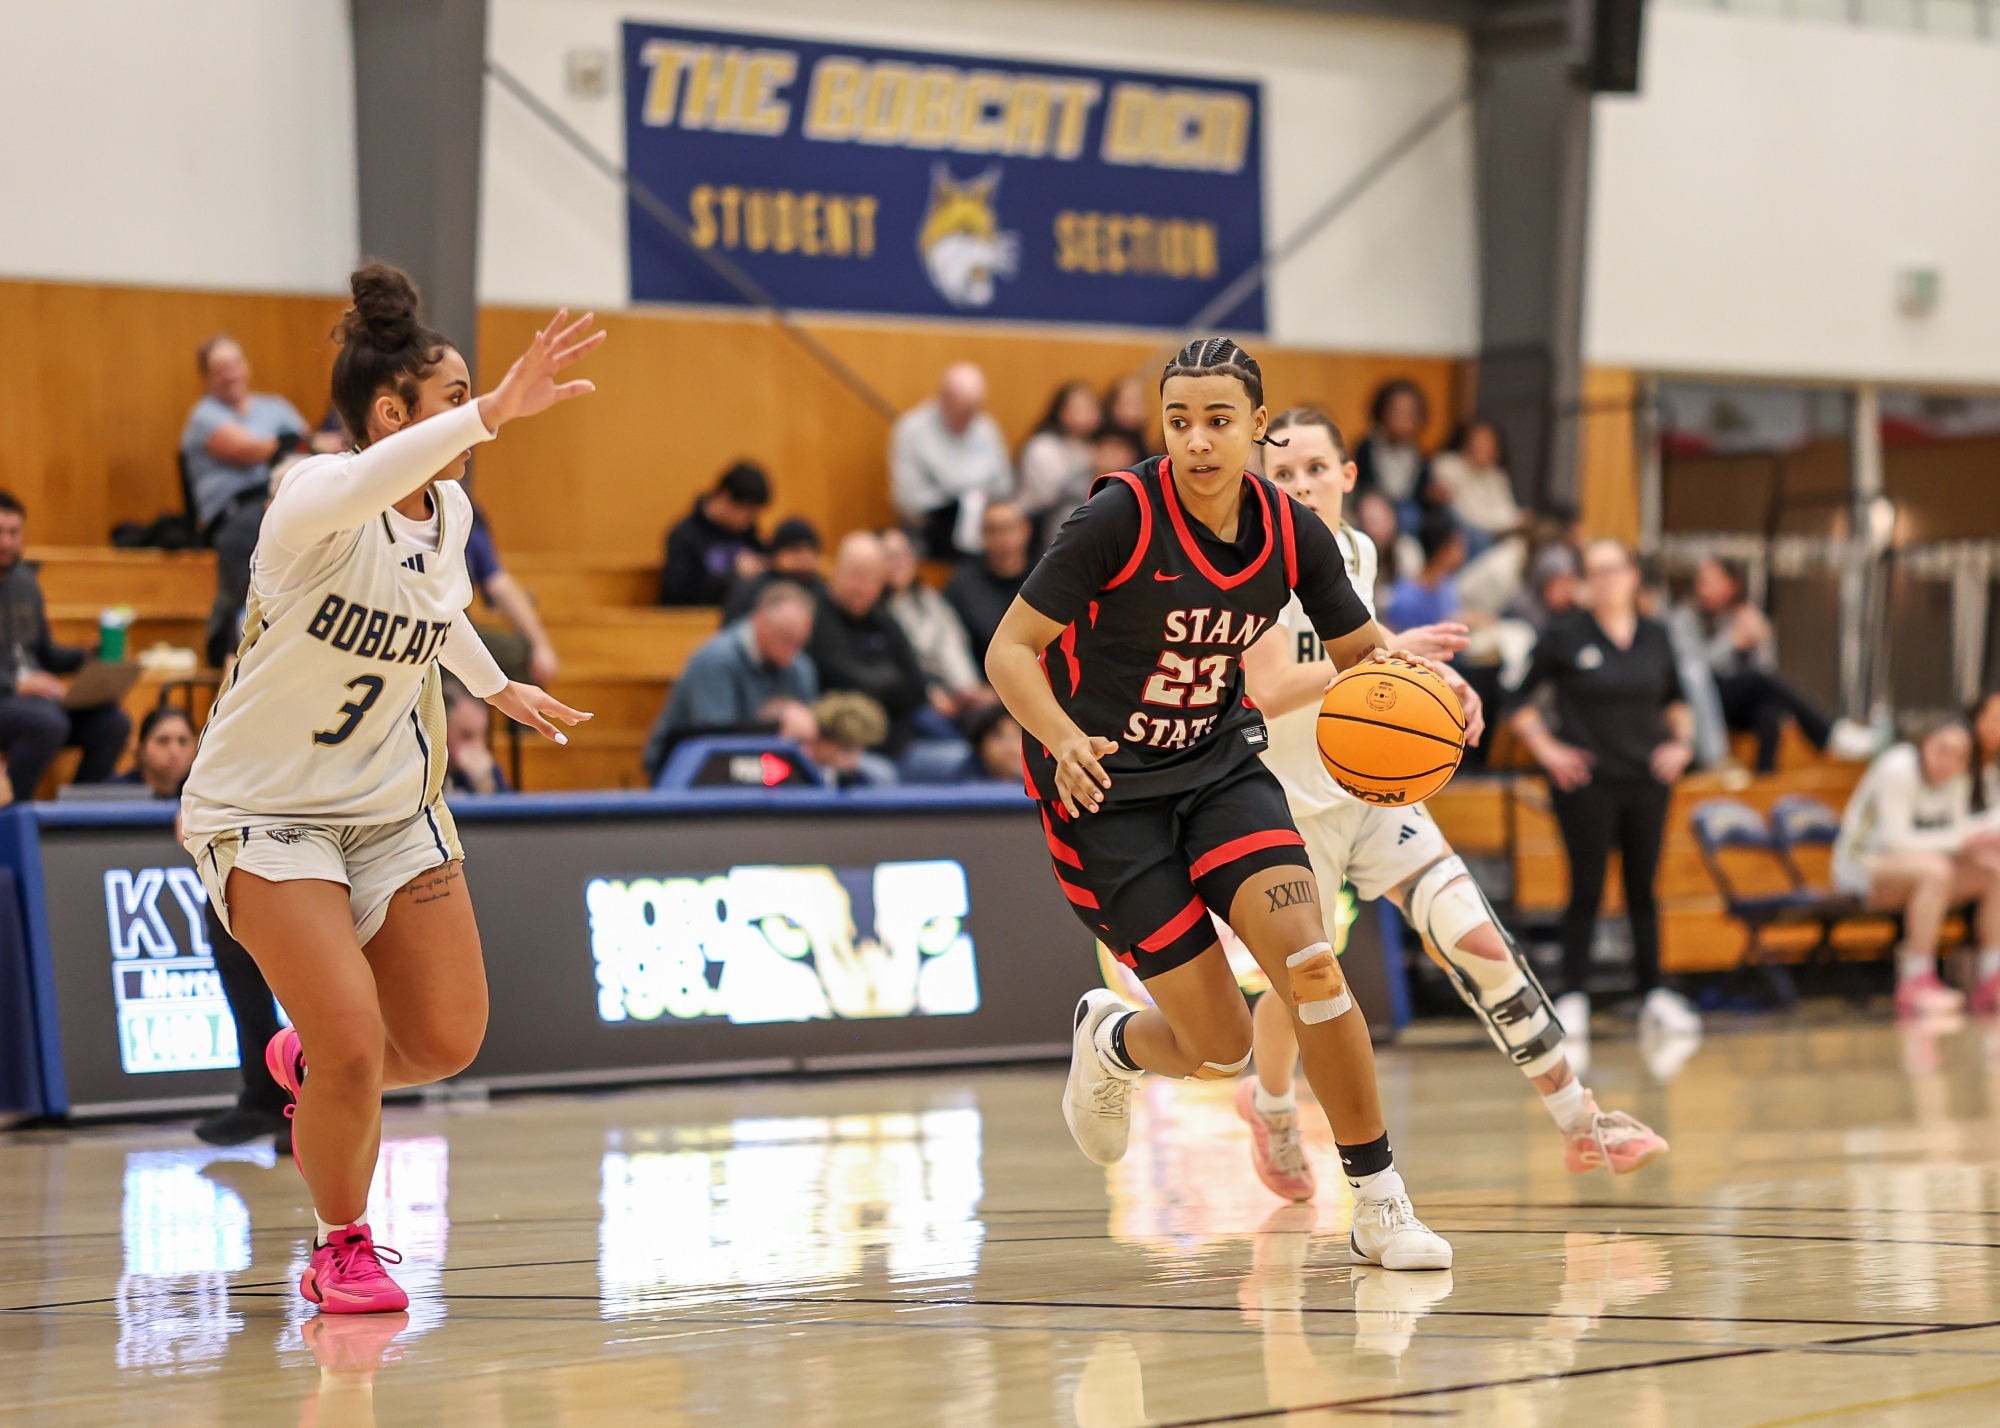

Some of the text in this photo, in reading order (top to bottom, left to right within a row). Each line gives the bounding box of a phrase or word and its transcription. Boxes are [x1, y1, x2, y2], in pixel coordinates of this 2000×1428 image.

[640, 41, 1253, 174] THE BOBCAT DEN
[689, 184, 1219, 279] STUDENT SECTION
[1163, 607, 1268, 646] STAN
[312, 672, 386, 747] 3
[1142, 649, 1235, 708] 23
[1264, 880, 1315, 914] XXIII
